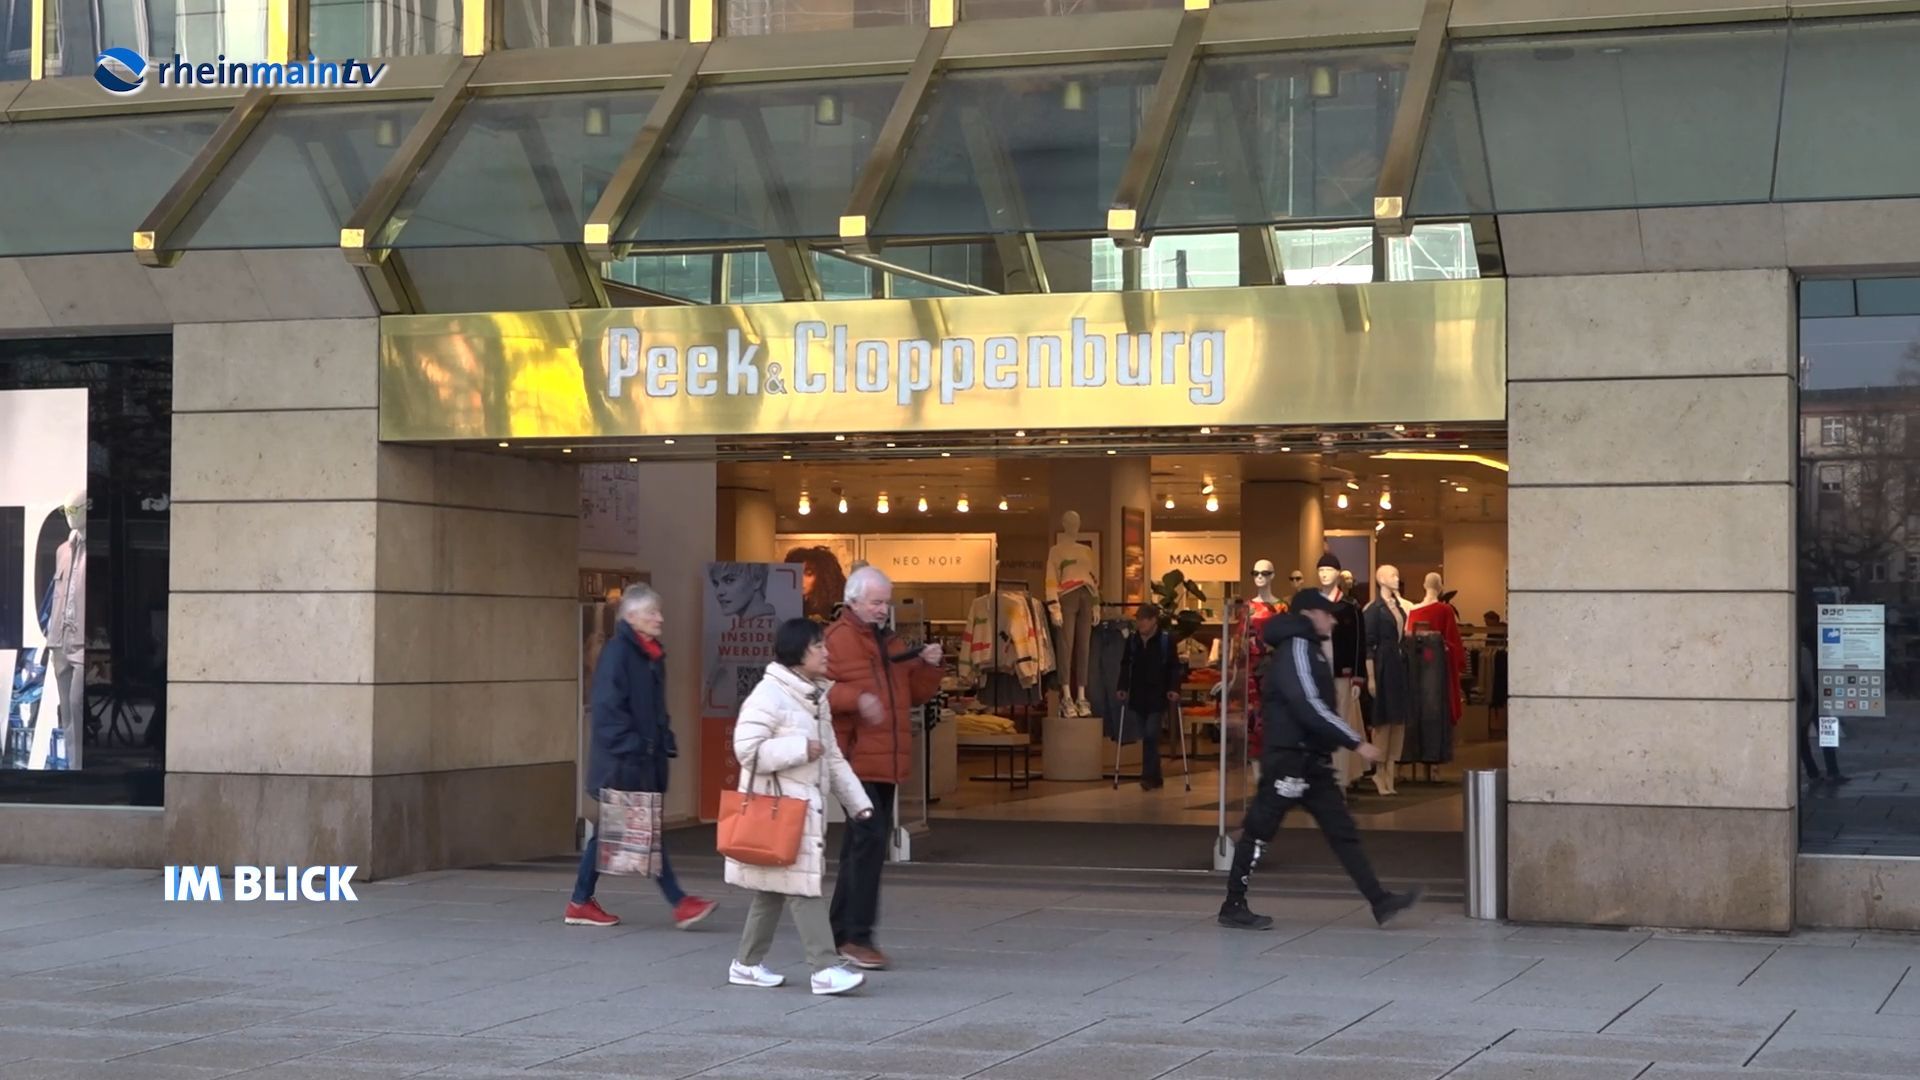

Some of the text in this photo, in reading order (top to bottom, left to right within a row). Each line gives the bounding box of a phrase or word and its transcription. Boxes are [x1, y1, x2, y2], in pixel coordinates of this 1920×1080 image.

[607, 326, 761, 398] Peek
[793, 317, 1226, 405] Cloppenburg
[892, 555, 962, 566] NEO NOIR
[1169, 553, 1228, 565] MANGO
[730, 618, 775, 631] JETZT
[721, 631, 775, 643] INSIDE
